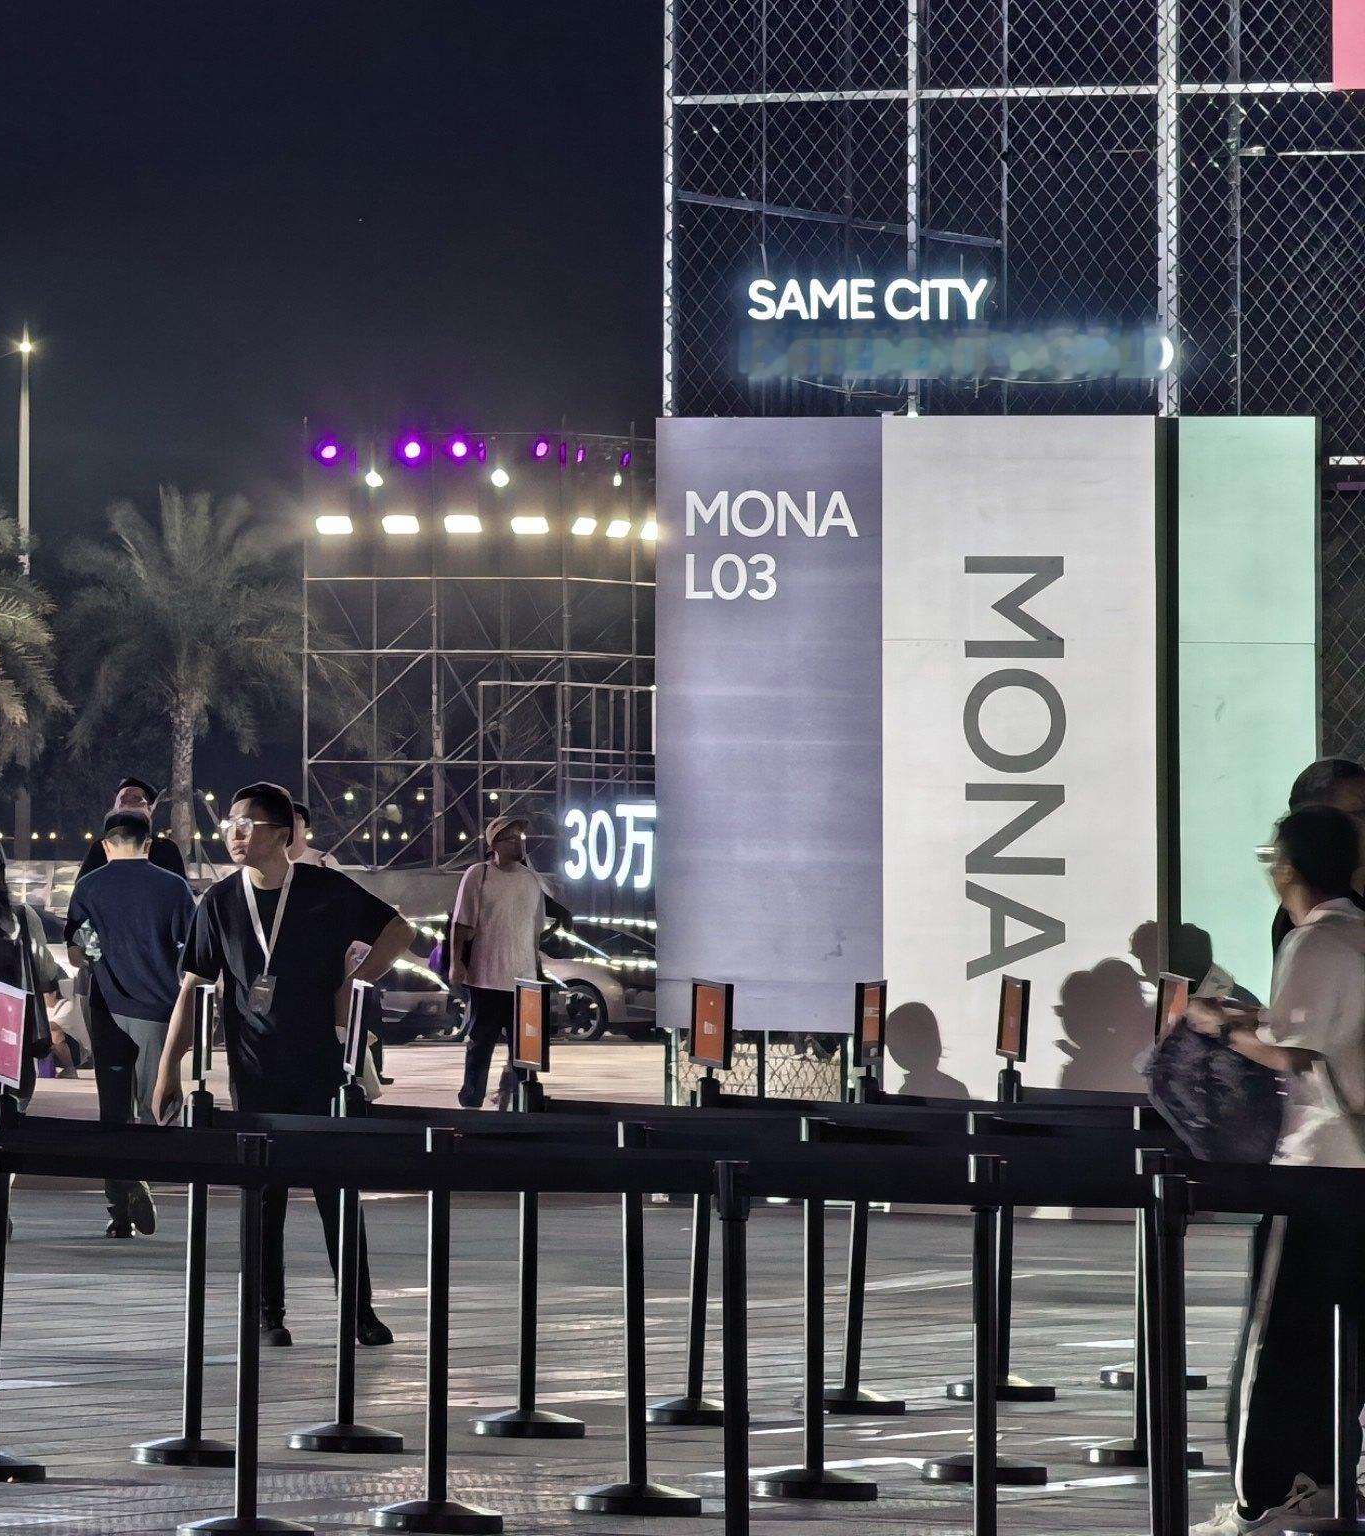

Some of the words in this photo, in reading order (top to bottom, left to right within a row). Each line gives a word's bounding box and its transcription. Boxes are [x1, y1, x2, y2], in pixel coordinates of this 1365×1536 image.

[747, 278, 875, 321] SAME
[884, 278, 988, 321] CITY
[685, 489, 859, 538] MONA
[685, 553, 778, 601] L03
[962, 555, 1067, 980] MONA
